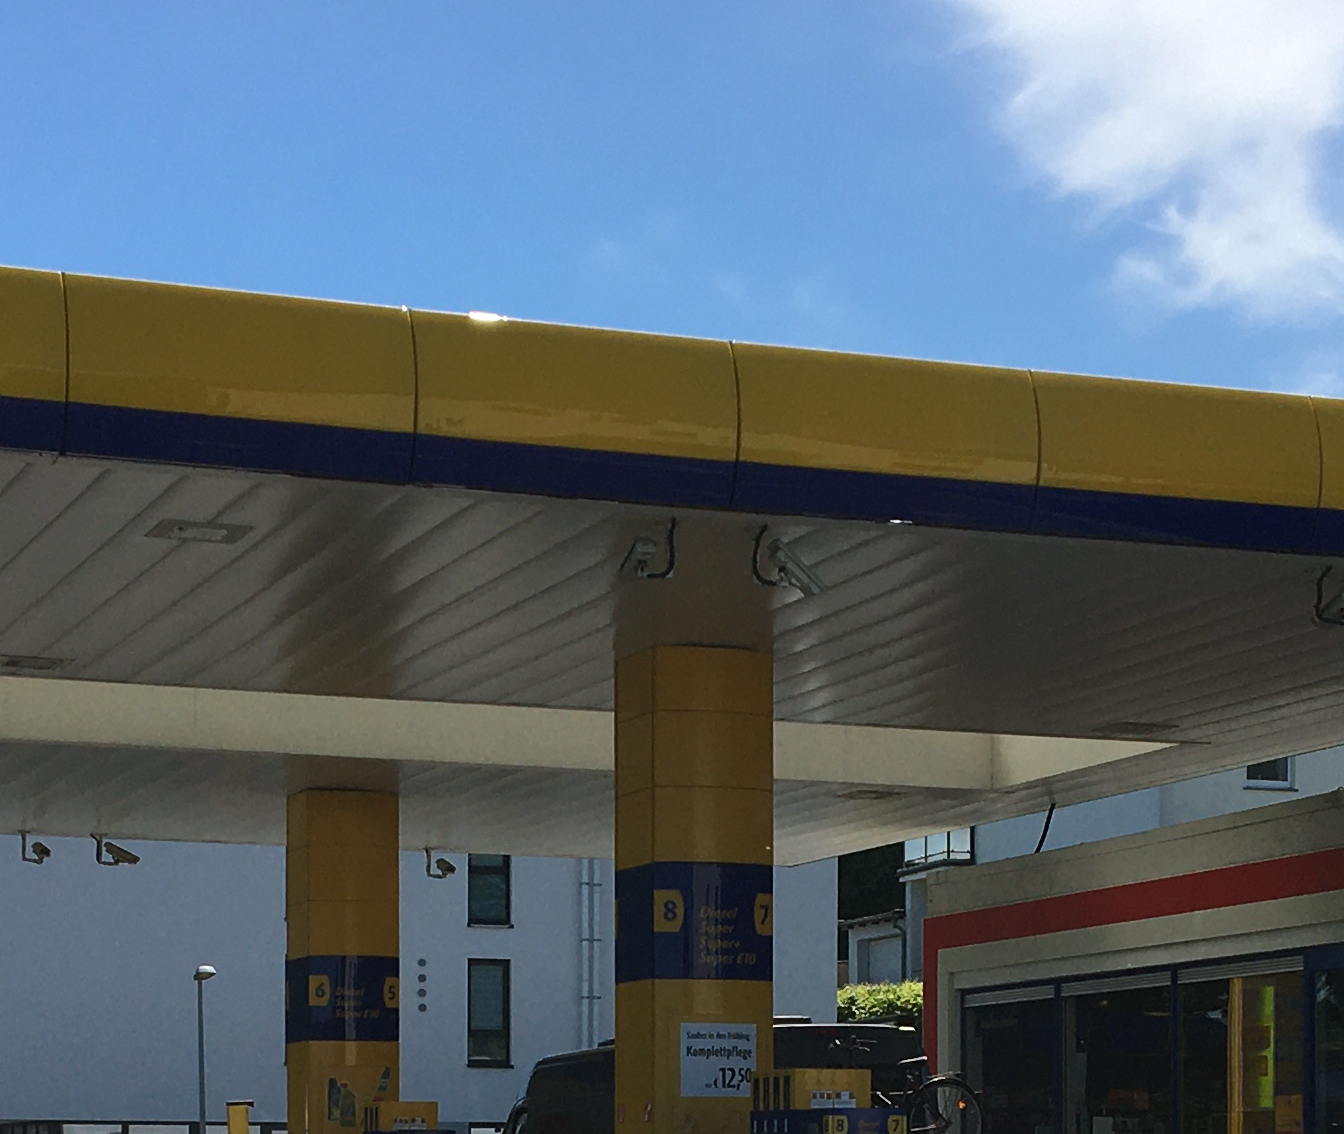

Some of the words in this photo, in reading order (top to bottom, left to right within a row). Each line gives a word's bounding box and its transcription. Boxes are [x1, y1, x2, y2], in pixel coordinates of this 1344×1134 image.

[663, 901, 677, 921] 8
[699, 906, 738, 918] Diesel
[760, 905, 769, 925] 7
[699, 921, 735, 934] Super
[699, 951, 734, 966] Super
[736, 953, 756, 964] E10
[316, 983, 325, 998] 6
[388, 985, 396, 1000] 5
[686, 1045, 752, 1060] Komplettpflege
[836, 1119, 844, 1132] 8
[892, 1119, 900, 1132] 7
